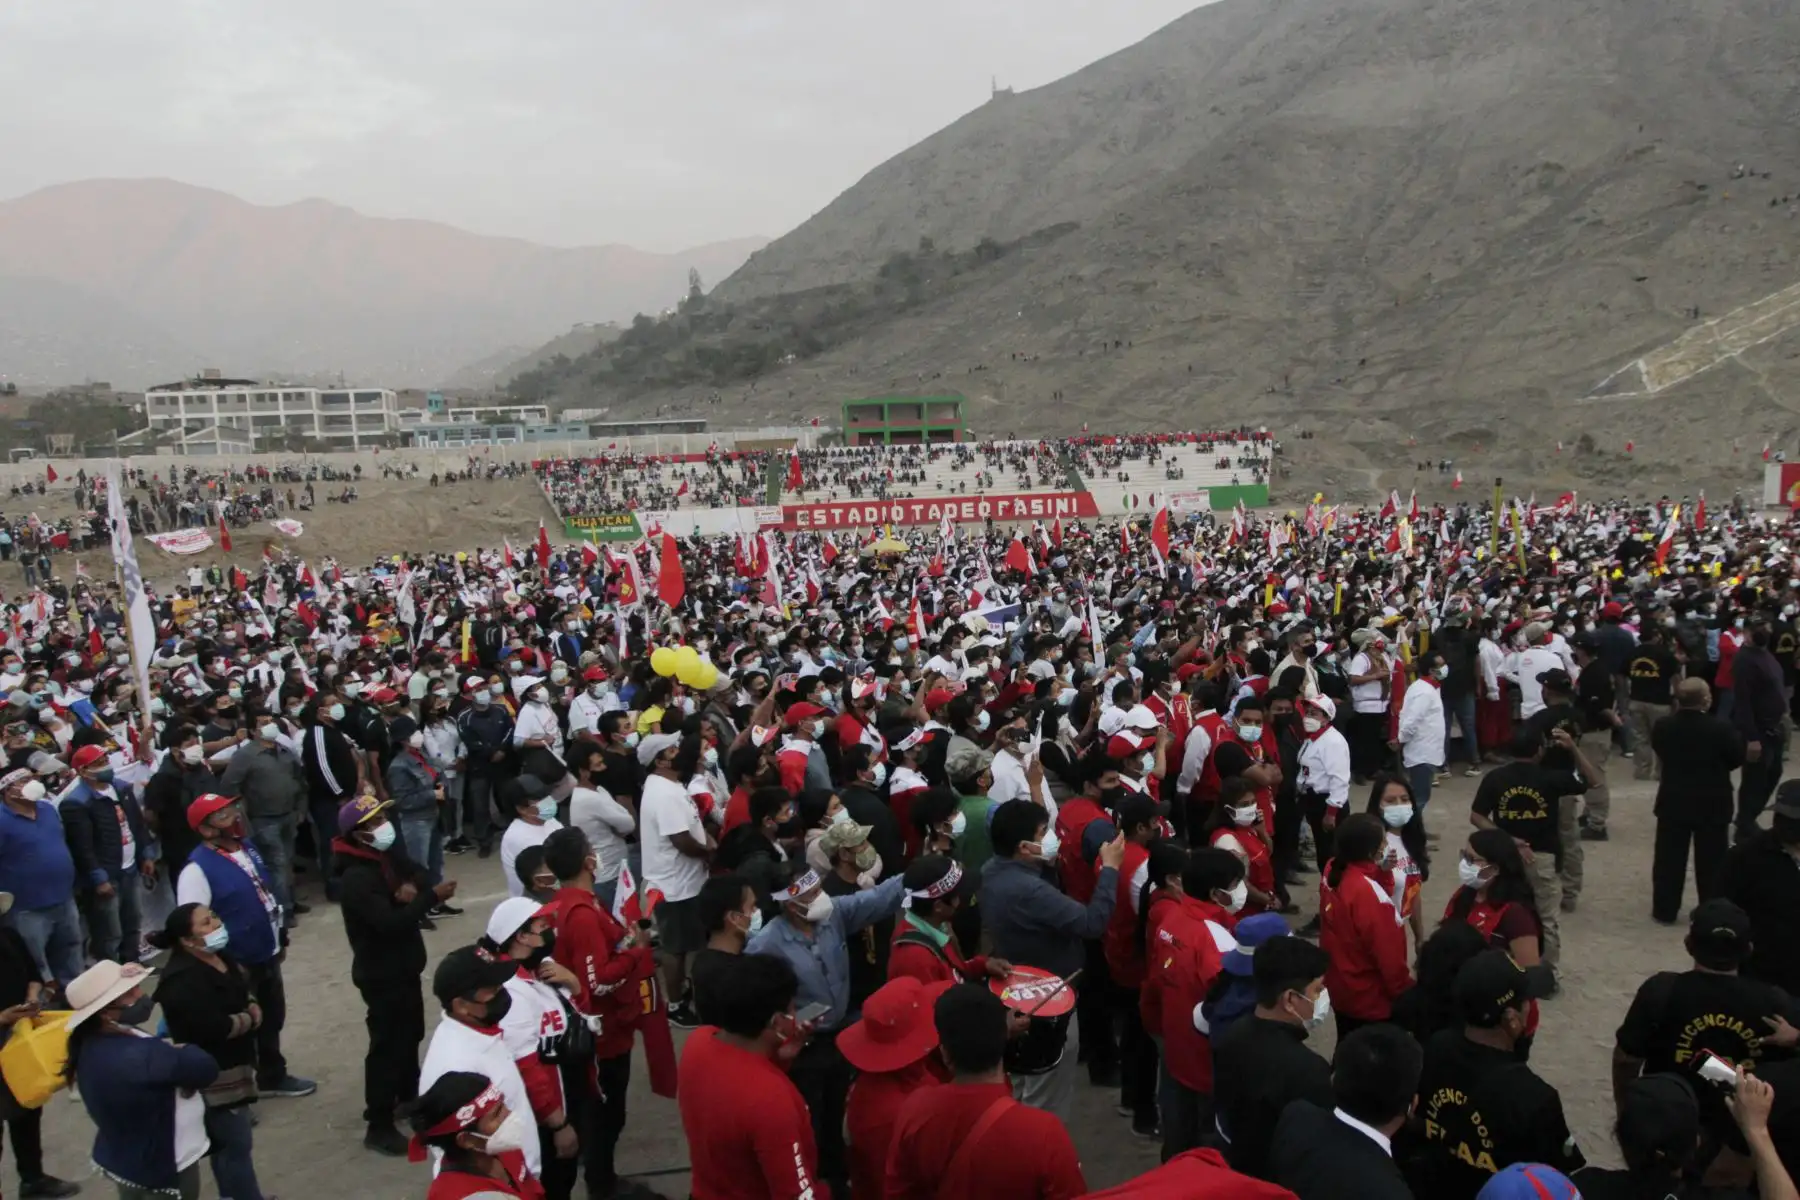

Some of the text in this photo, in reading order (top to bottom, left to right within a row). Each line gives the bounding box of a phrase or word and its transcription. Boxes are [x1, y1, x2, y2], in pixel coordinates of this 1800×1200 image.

[796, 504, 904, 526] ESTADIO
[911, 501, 989, 521] TADEO
[1426, 1087, 1494, 1149] LICENCIDOS
